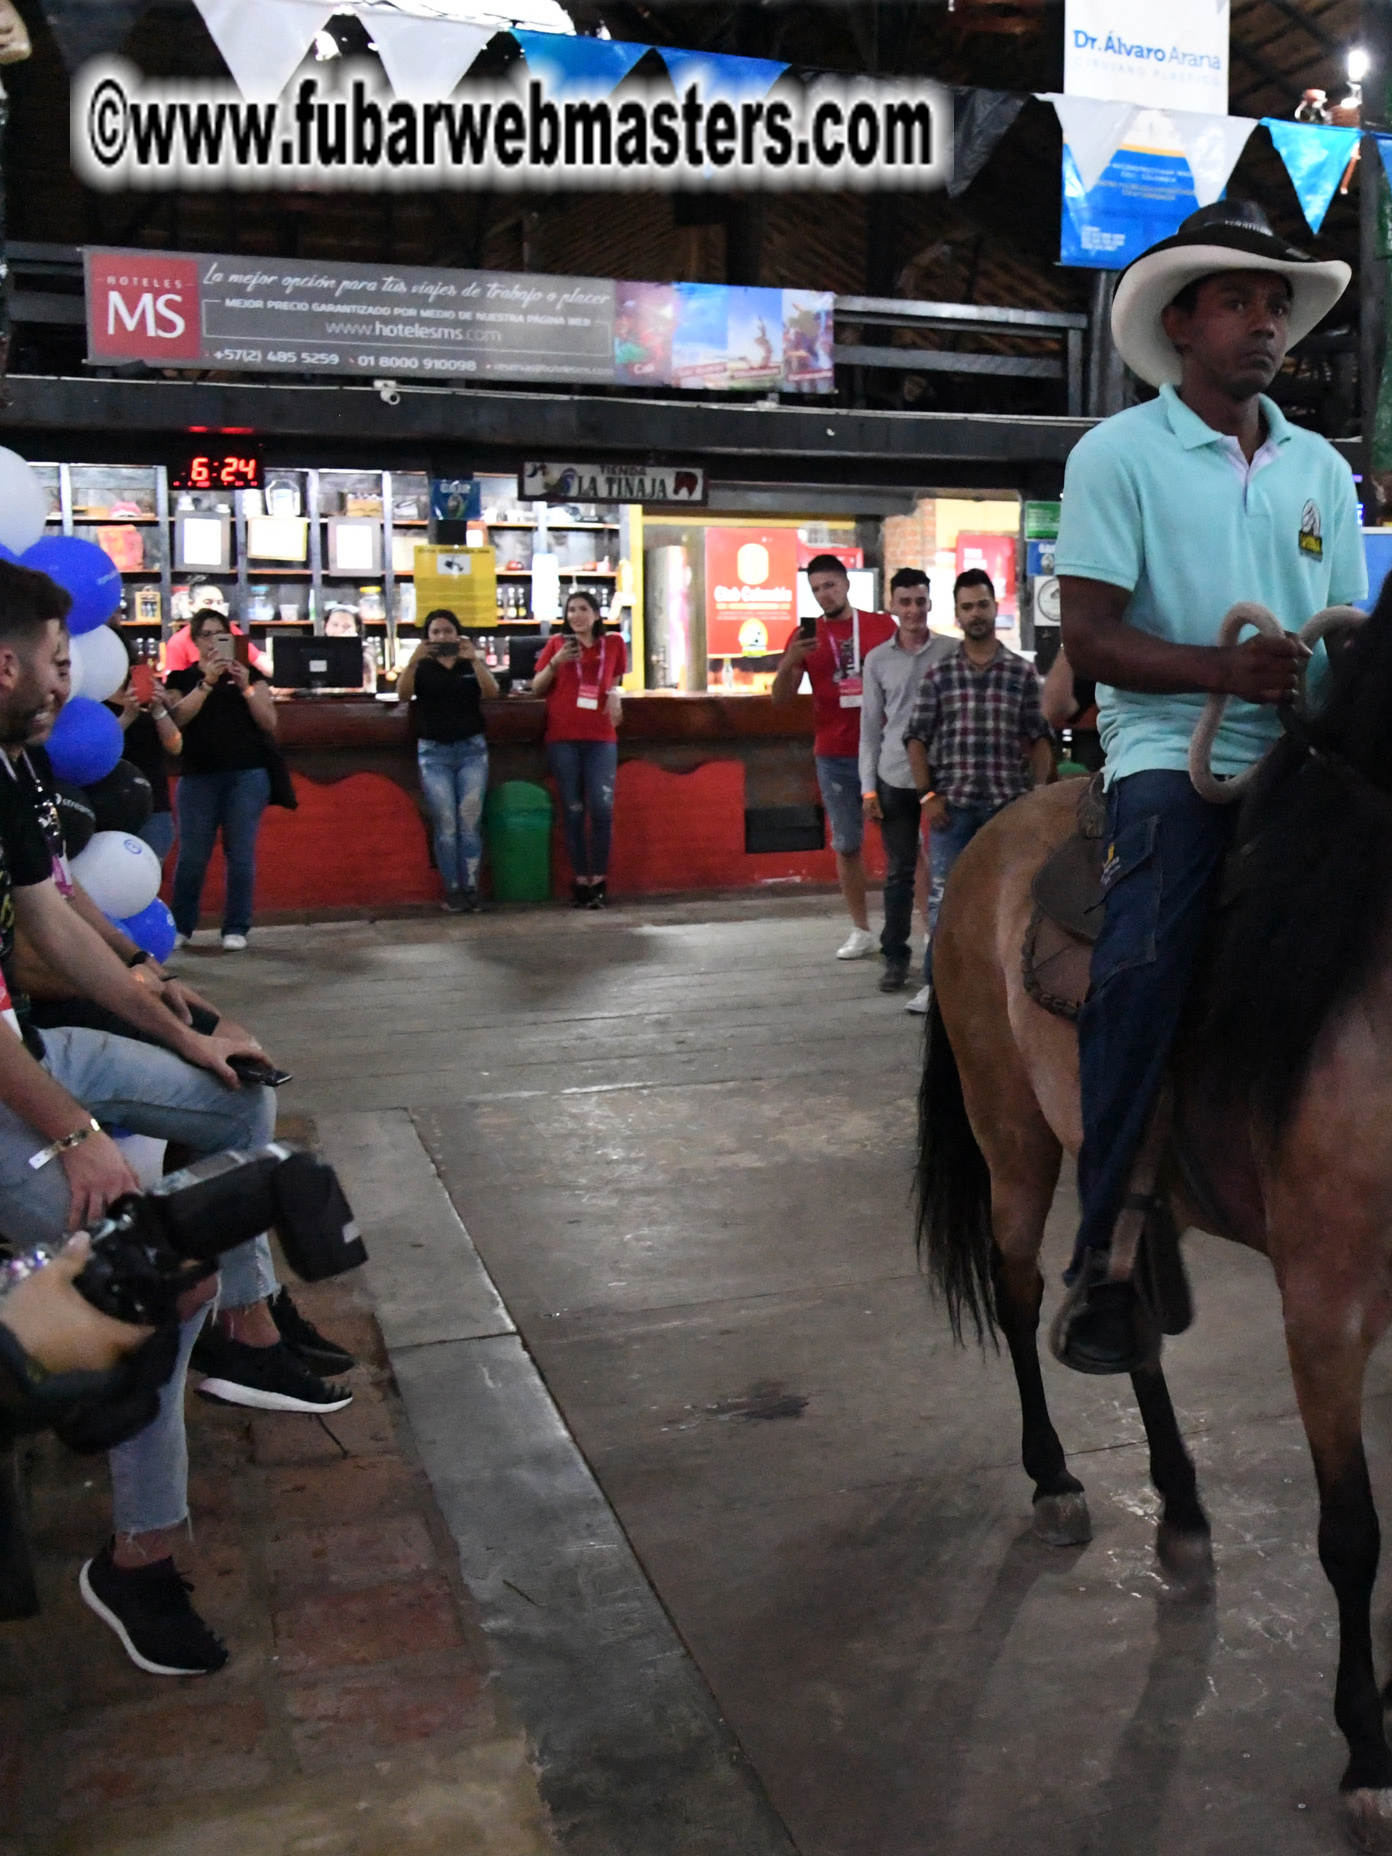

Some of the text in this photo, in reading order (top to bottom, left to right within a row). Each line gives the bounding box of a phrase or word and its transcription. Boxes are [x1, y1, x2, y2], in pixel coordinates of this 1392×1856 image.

[1073, 29, 1221, 70] Dr. Álvaro Arana
[107, 276, 183, 289] HOTELES
[203, 262, 611, 311] La mejor opción para tus viajes de trabajo o placer
[107, 290, 186, 339] MS
[225, 298, 264, 310] MEJOR
[267, 300, 309, 312] PRECIO
[312, 303, 391, 316] GARANTIZADO
[394, 307, 418, 317] POR
[420, 309, 455, 320] MEDIO
[458, 311, 473, 321] DE
[476, 311, 525, 324] NUESTRA
[568, 316, 592, 327] WEB
[325, 320, 501, 342] www.hotelesms.com
[214, 349, 262, 363] +57(2)
[267, 351, 298, 363] 485
[301, 352, 340, 365] 5259
[358, 355, 375, 367] 01
[378, 356, 419, 369] 8000
[422, 358, 477, 372] 910098
[191, 456, 257, 482] 6:24
[577, 475, 668, 498] LA TINAJA
